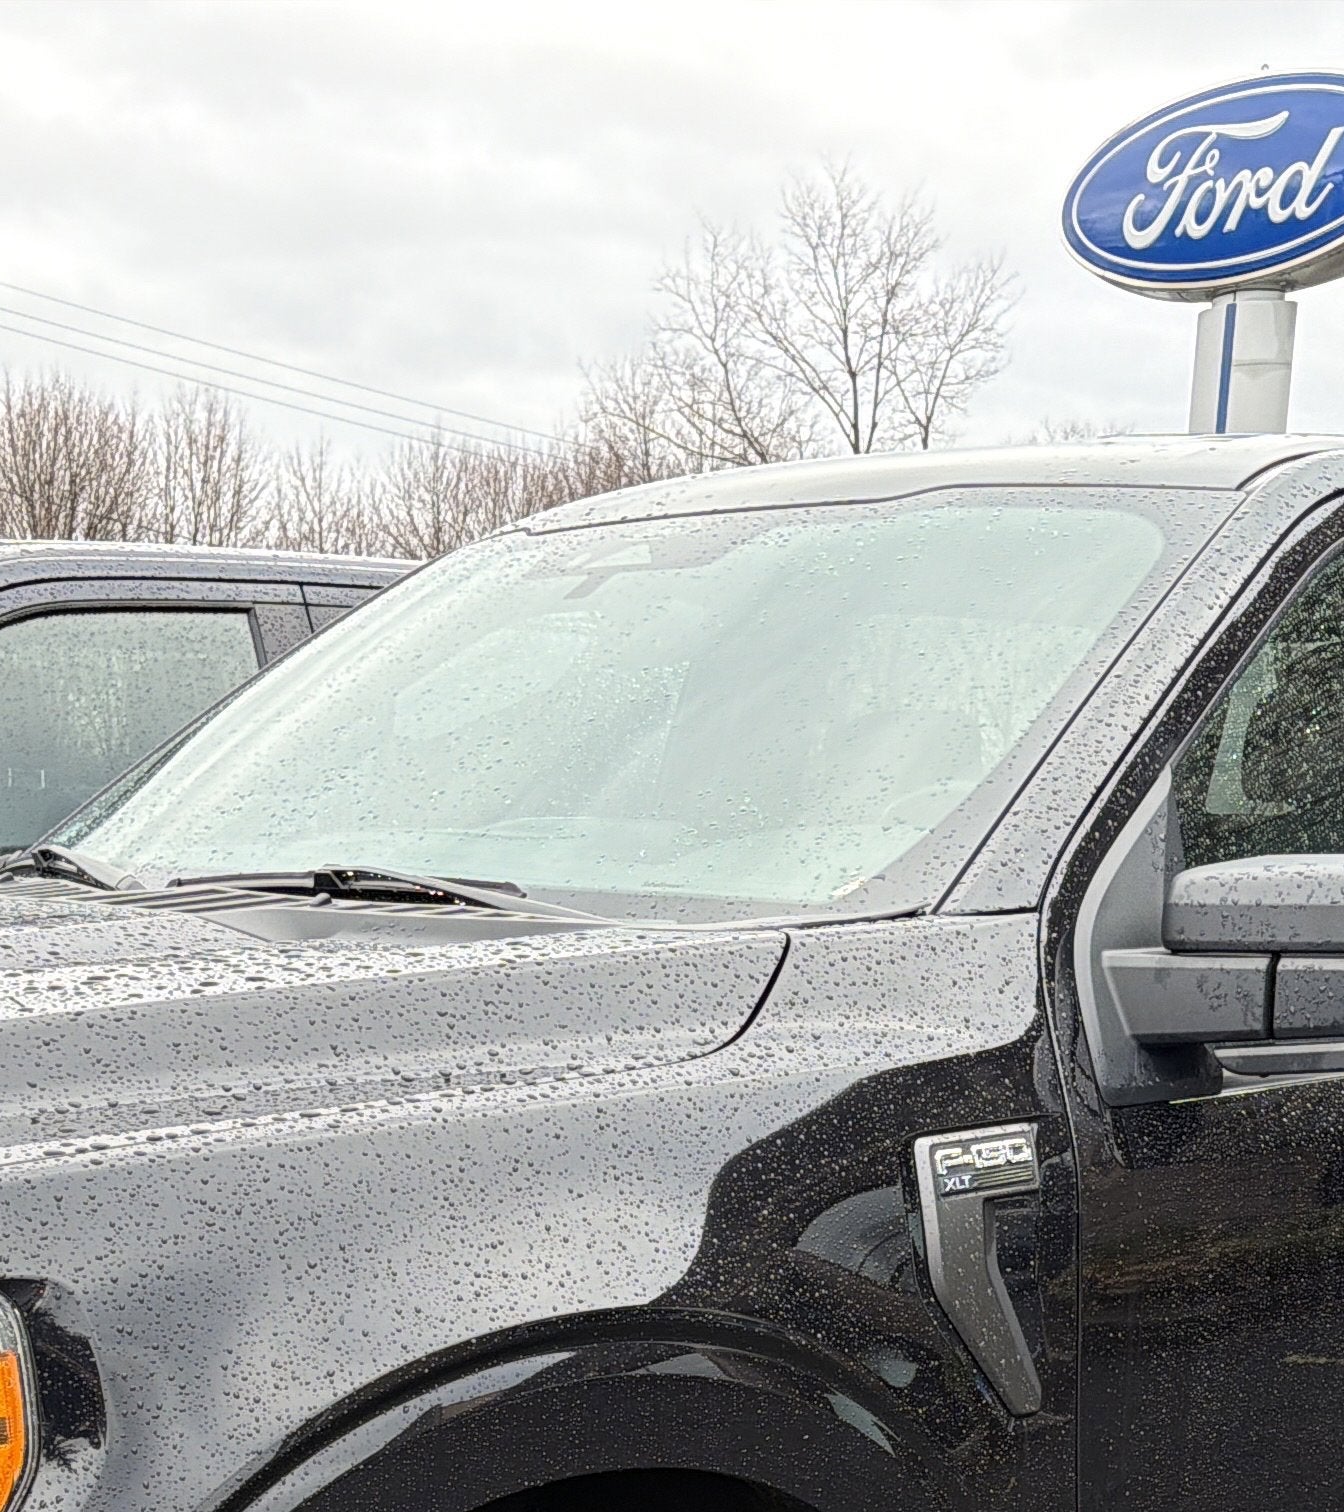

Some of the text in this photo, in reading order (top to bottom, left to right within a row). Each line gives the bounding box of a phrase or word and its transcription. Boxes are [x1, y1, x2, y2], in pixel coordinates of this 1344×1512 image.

[1121, 109, 1344, 252] Ford
[934, 1138, 1033, 1176] F-150
[943, 1175, 973, 1192] XLT
